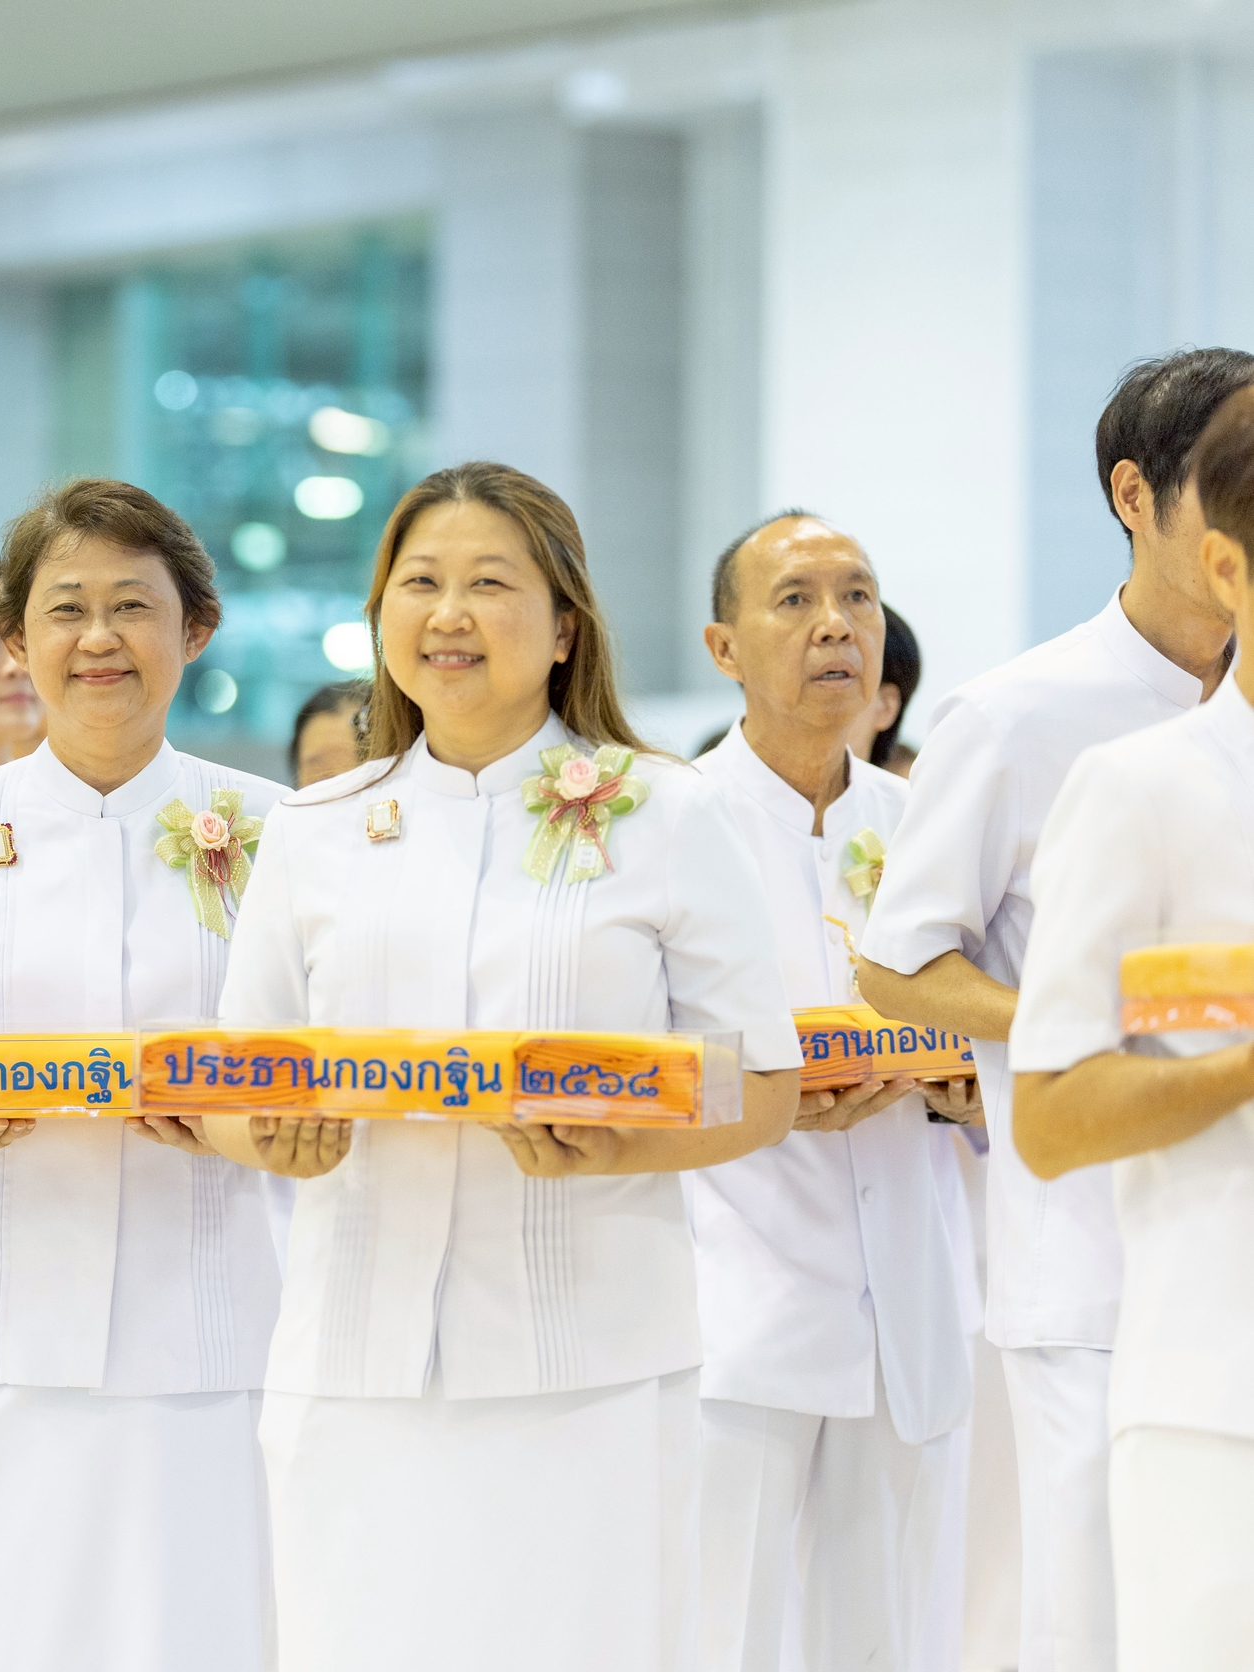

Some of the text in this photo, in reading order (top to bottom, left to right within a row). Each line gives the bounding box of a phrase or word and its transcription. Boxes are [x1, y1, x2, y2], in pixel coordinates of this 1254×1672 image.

[164, 1045, 660, 1106] ประธานกองกฐิน ๒๕๖๘
